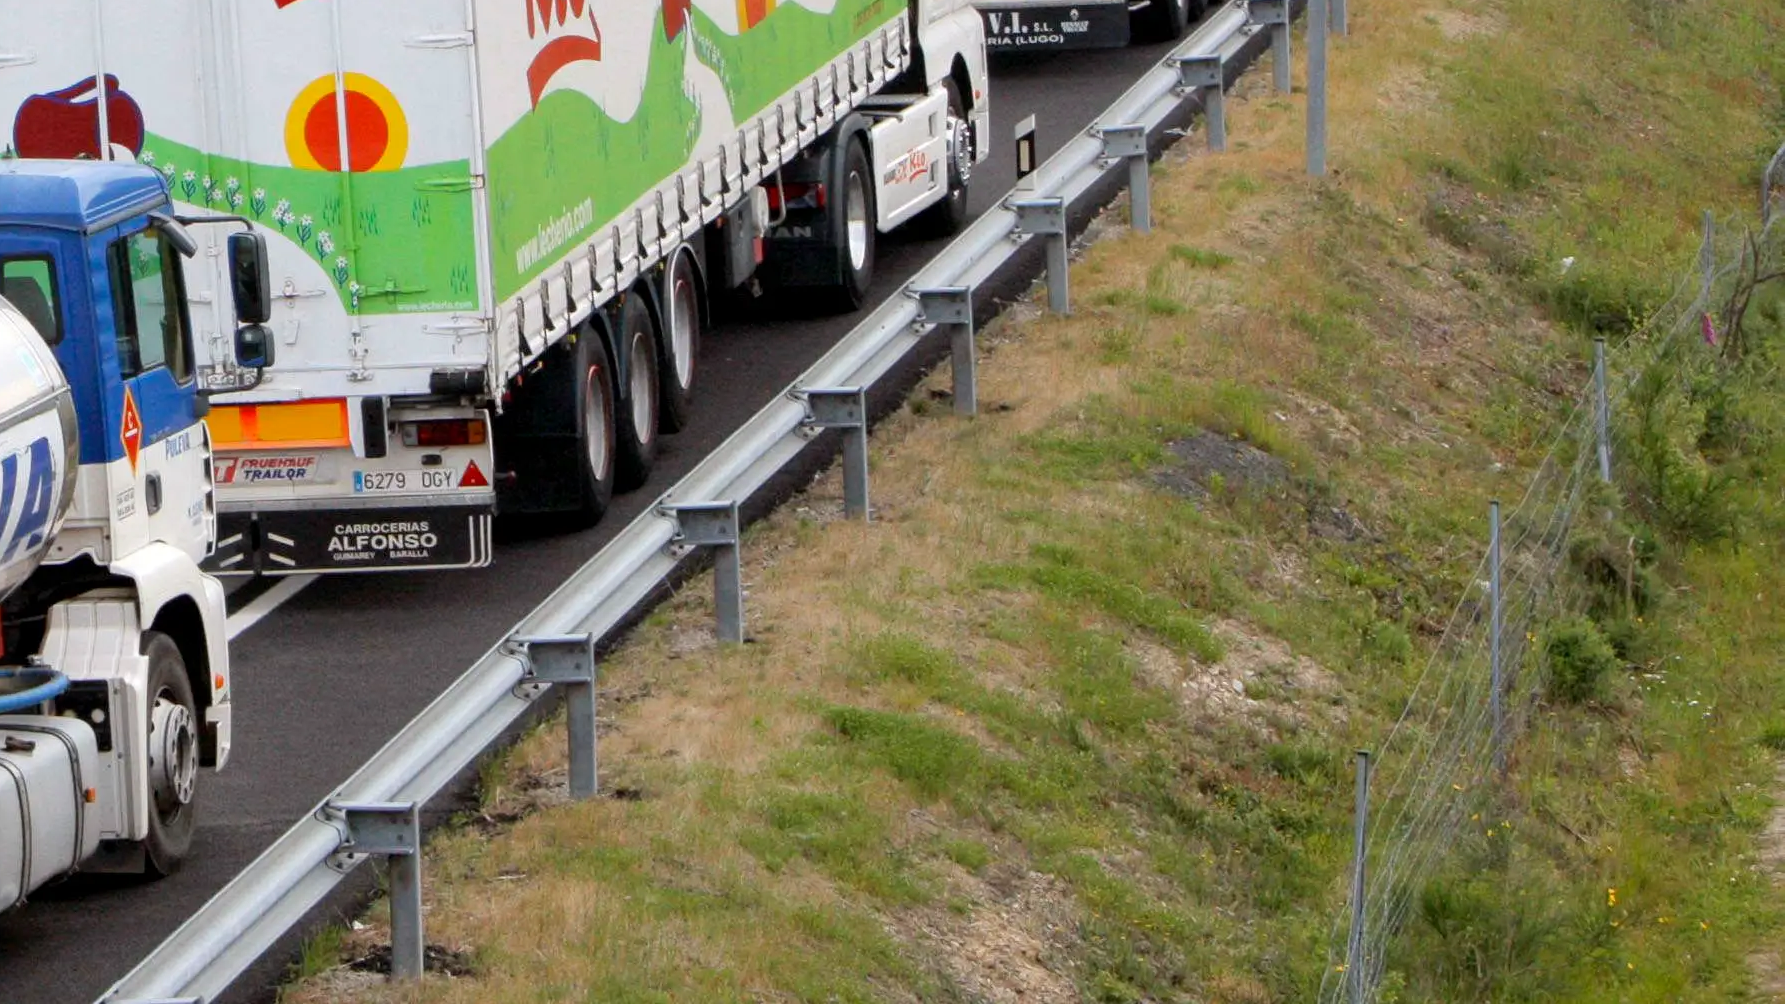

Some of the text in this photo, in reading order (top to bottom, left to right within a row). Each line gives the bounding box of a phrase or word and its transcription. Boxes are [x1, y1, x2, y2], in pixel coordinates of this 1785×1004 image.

[1015, 34, 1064, 46] (LUGO)
[165, 433, 191, 461] PULEVA
[241, 457, 315, 469] FRUEHAUF
[243, 468, 306, 482] TRAILOR
[364, 471, 452, 490] 6279 DGY
[335, 521, 430, 535] CARROCERIAS
[328, 533, 438, 552] ALFONSO
[389, 550, 428, 559] BARALLA
